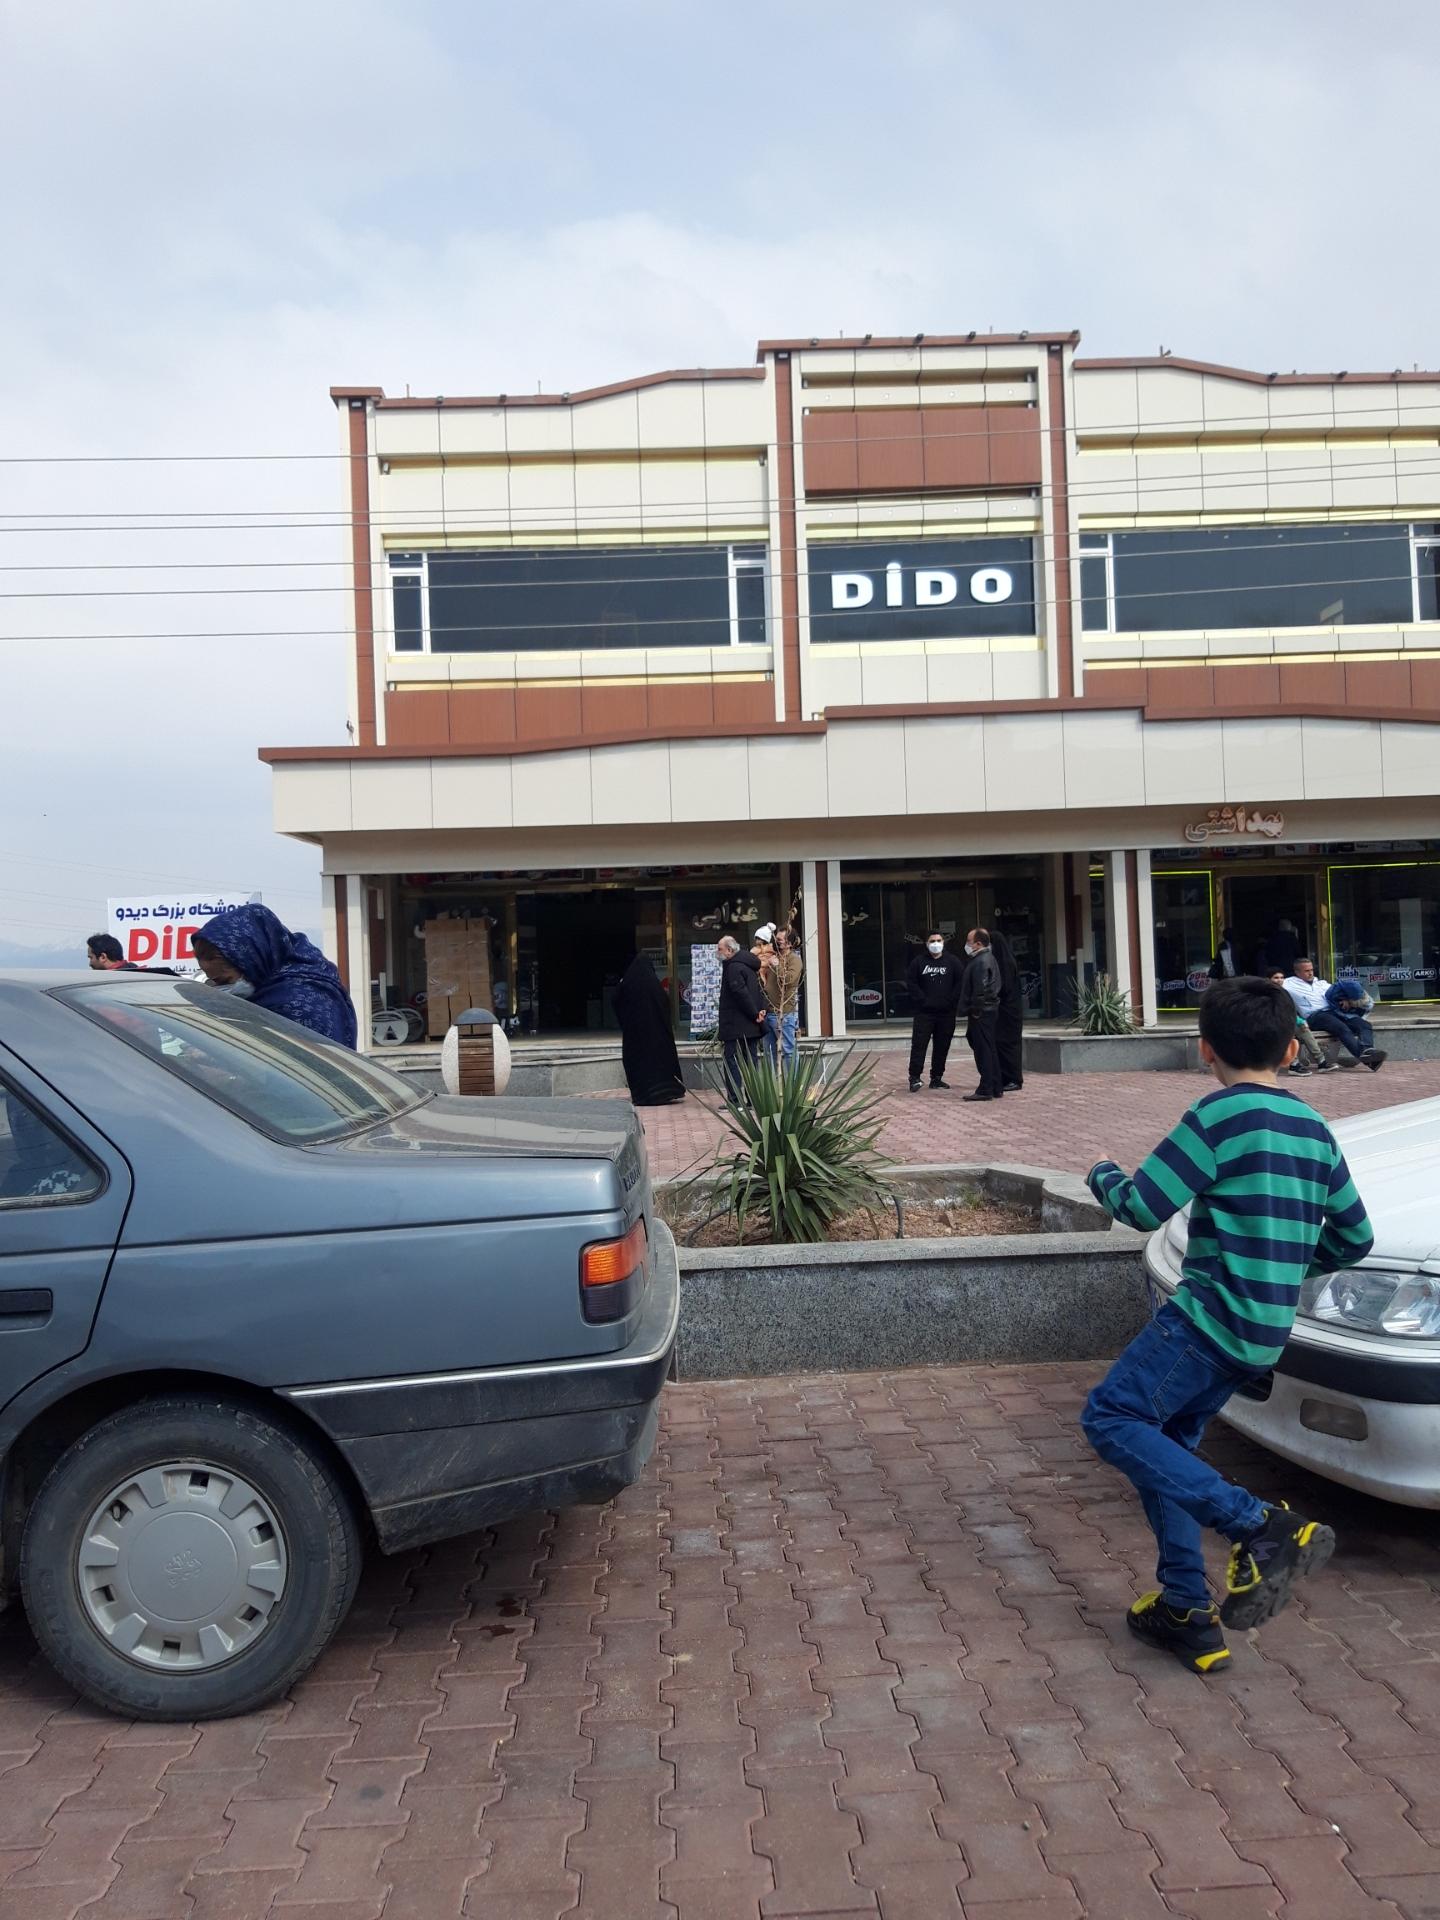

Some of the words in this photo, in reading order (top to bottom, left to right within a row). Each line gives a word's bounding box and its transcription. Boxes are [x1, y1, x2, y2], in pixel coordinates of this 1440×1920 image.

[1184, 805, 1284, 842] بهداشتی
[116, 907, 149, 921] دیدو
[152, 903, 186, 920] بزرگ
[692, 898, 759, 930] غذایی
[128, 923, 200, 962] DiD
[852, 993, 880, 1001] nutella
